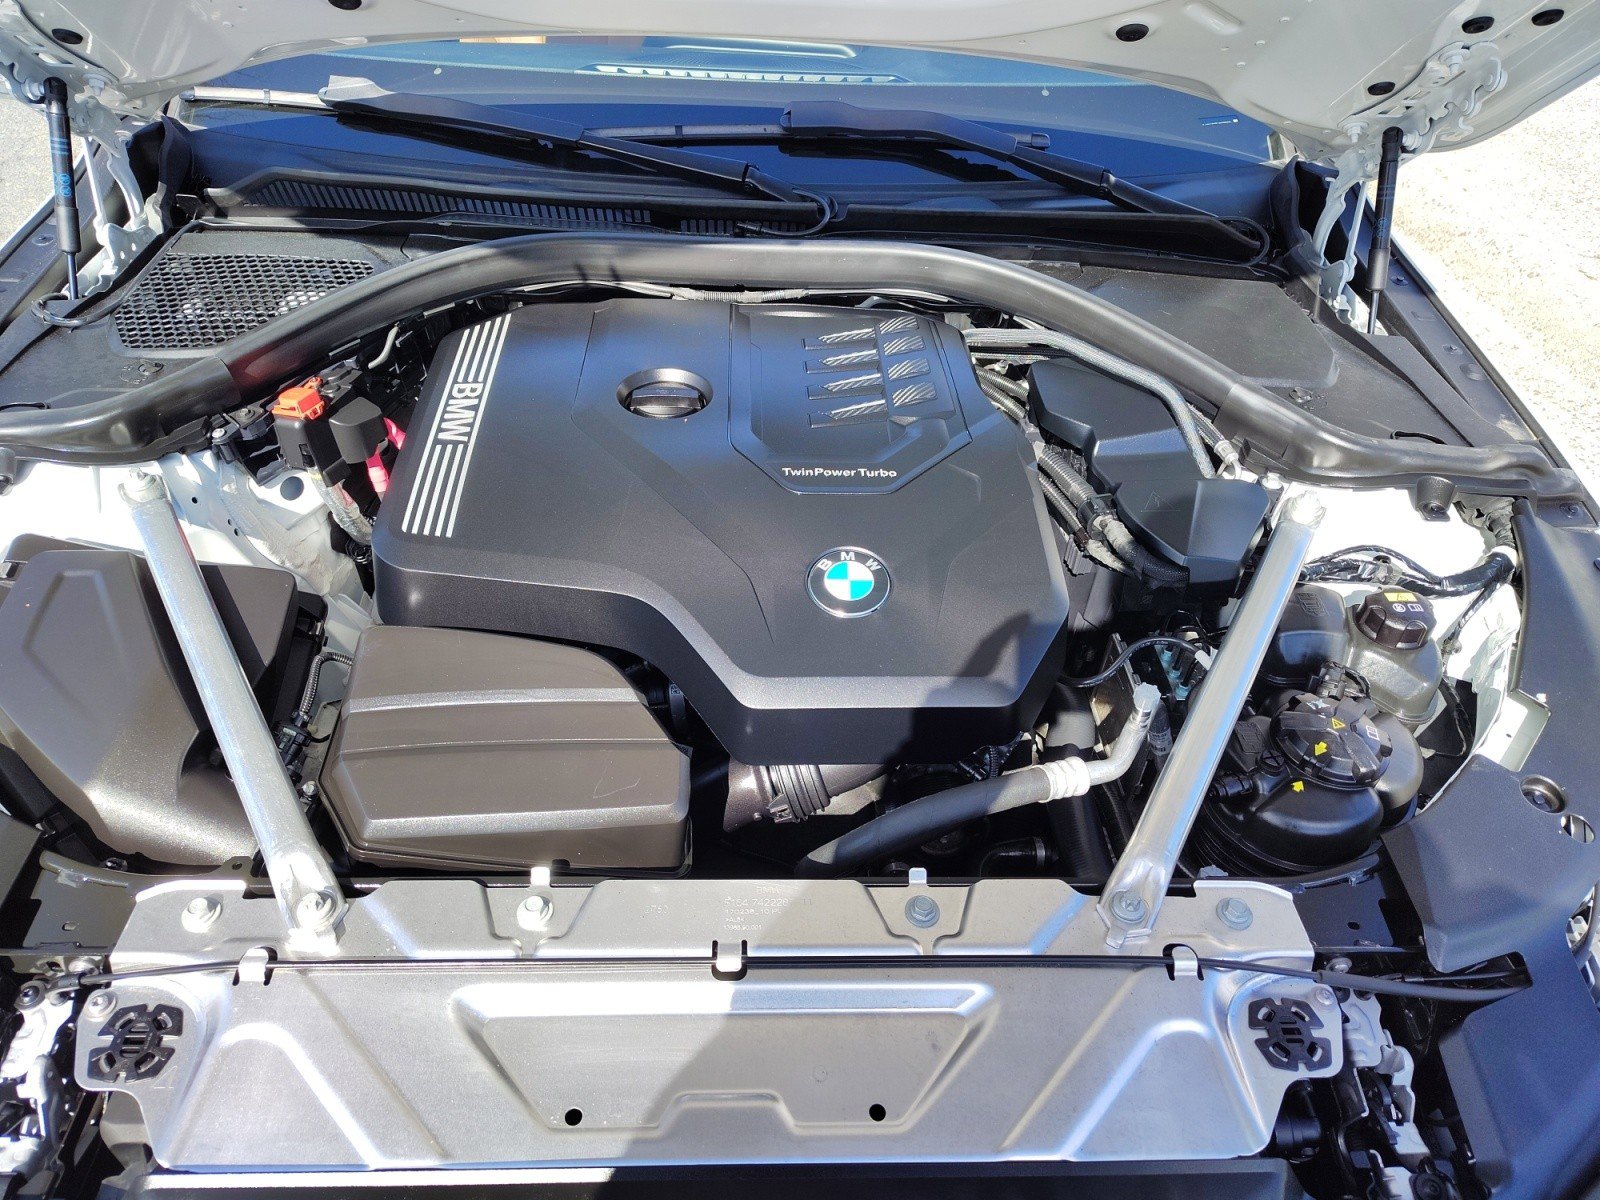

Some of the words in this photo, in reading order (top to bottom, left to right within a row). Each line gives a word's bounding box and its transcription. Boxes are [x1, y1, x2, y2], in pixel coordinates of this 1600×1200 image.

[437, 382, 484, 442] BMW
[858, 468, 898, 478] Turbo
[817, 551, 882, 571] BMW
